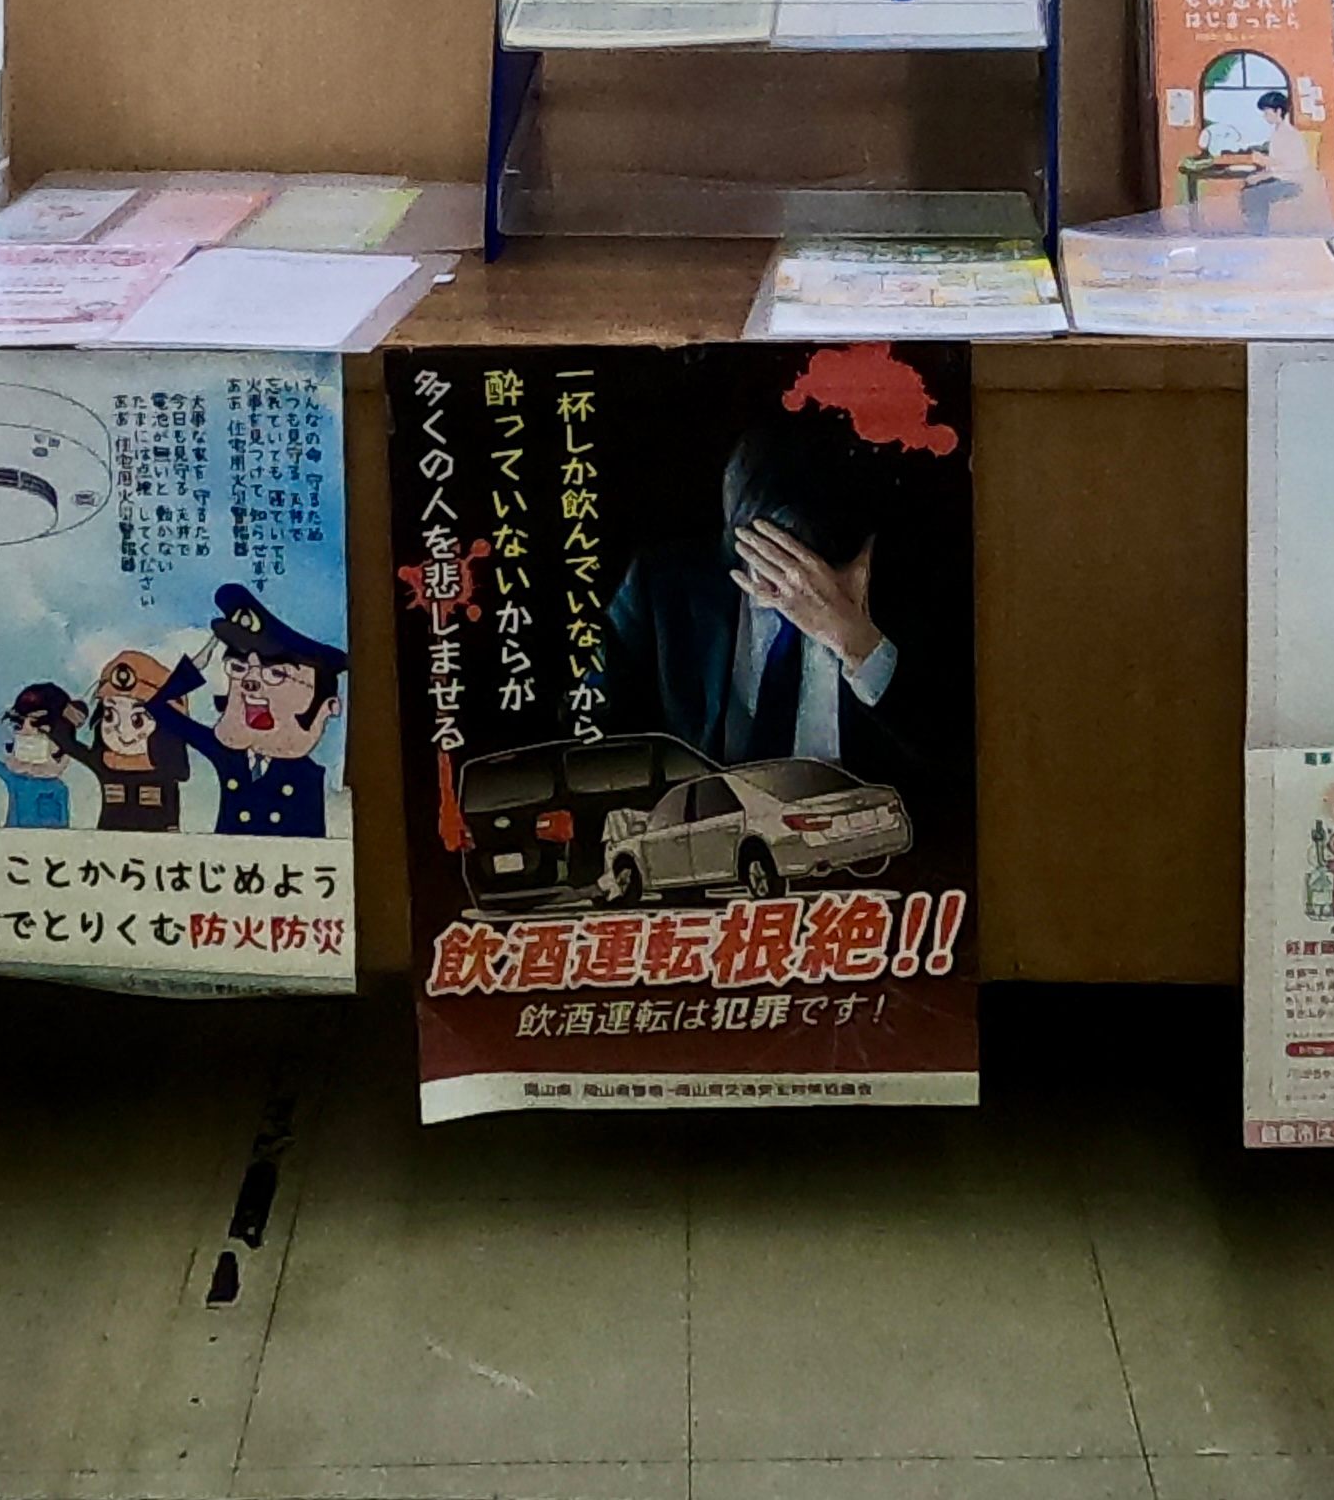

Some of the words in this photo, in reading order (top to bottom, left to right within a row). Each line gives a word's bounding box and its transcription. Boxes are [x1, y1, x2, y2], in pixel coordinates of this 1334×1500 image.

[1184, 11, 1300, 31] はじまったら
[413, 368, 465, 752] 多くの人を悲しませる
[483, 368, 535, 712] 酔っていないからが
[555, 369, 606, 746] 一杯しか飲んでいないから
[429, 890, 967, 995] 飲酒運転根絶!!
[516, 993, 887, 1038] 飲酒運転は犯罪です!
